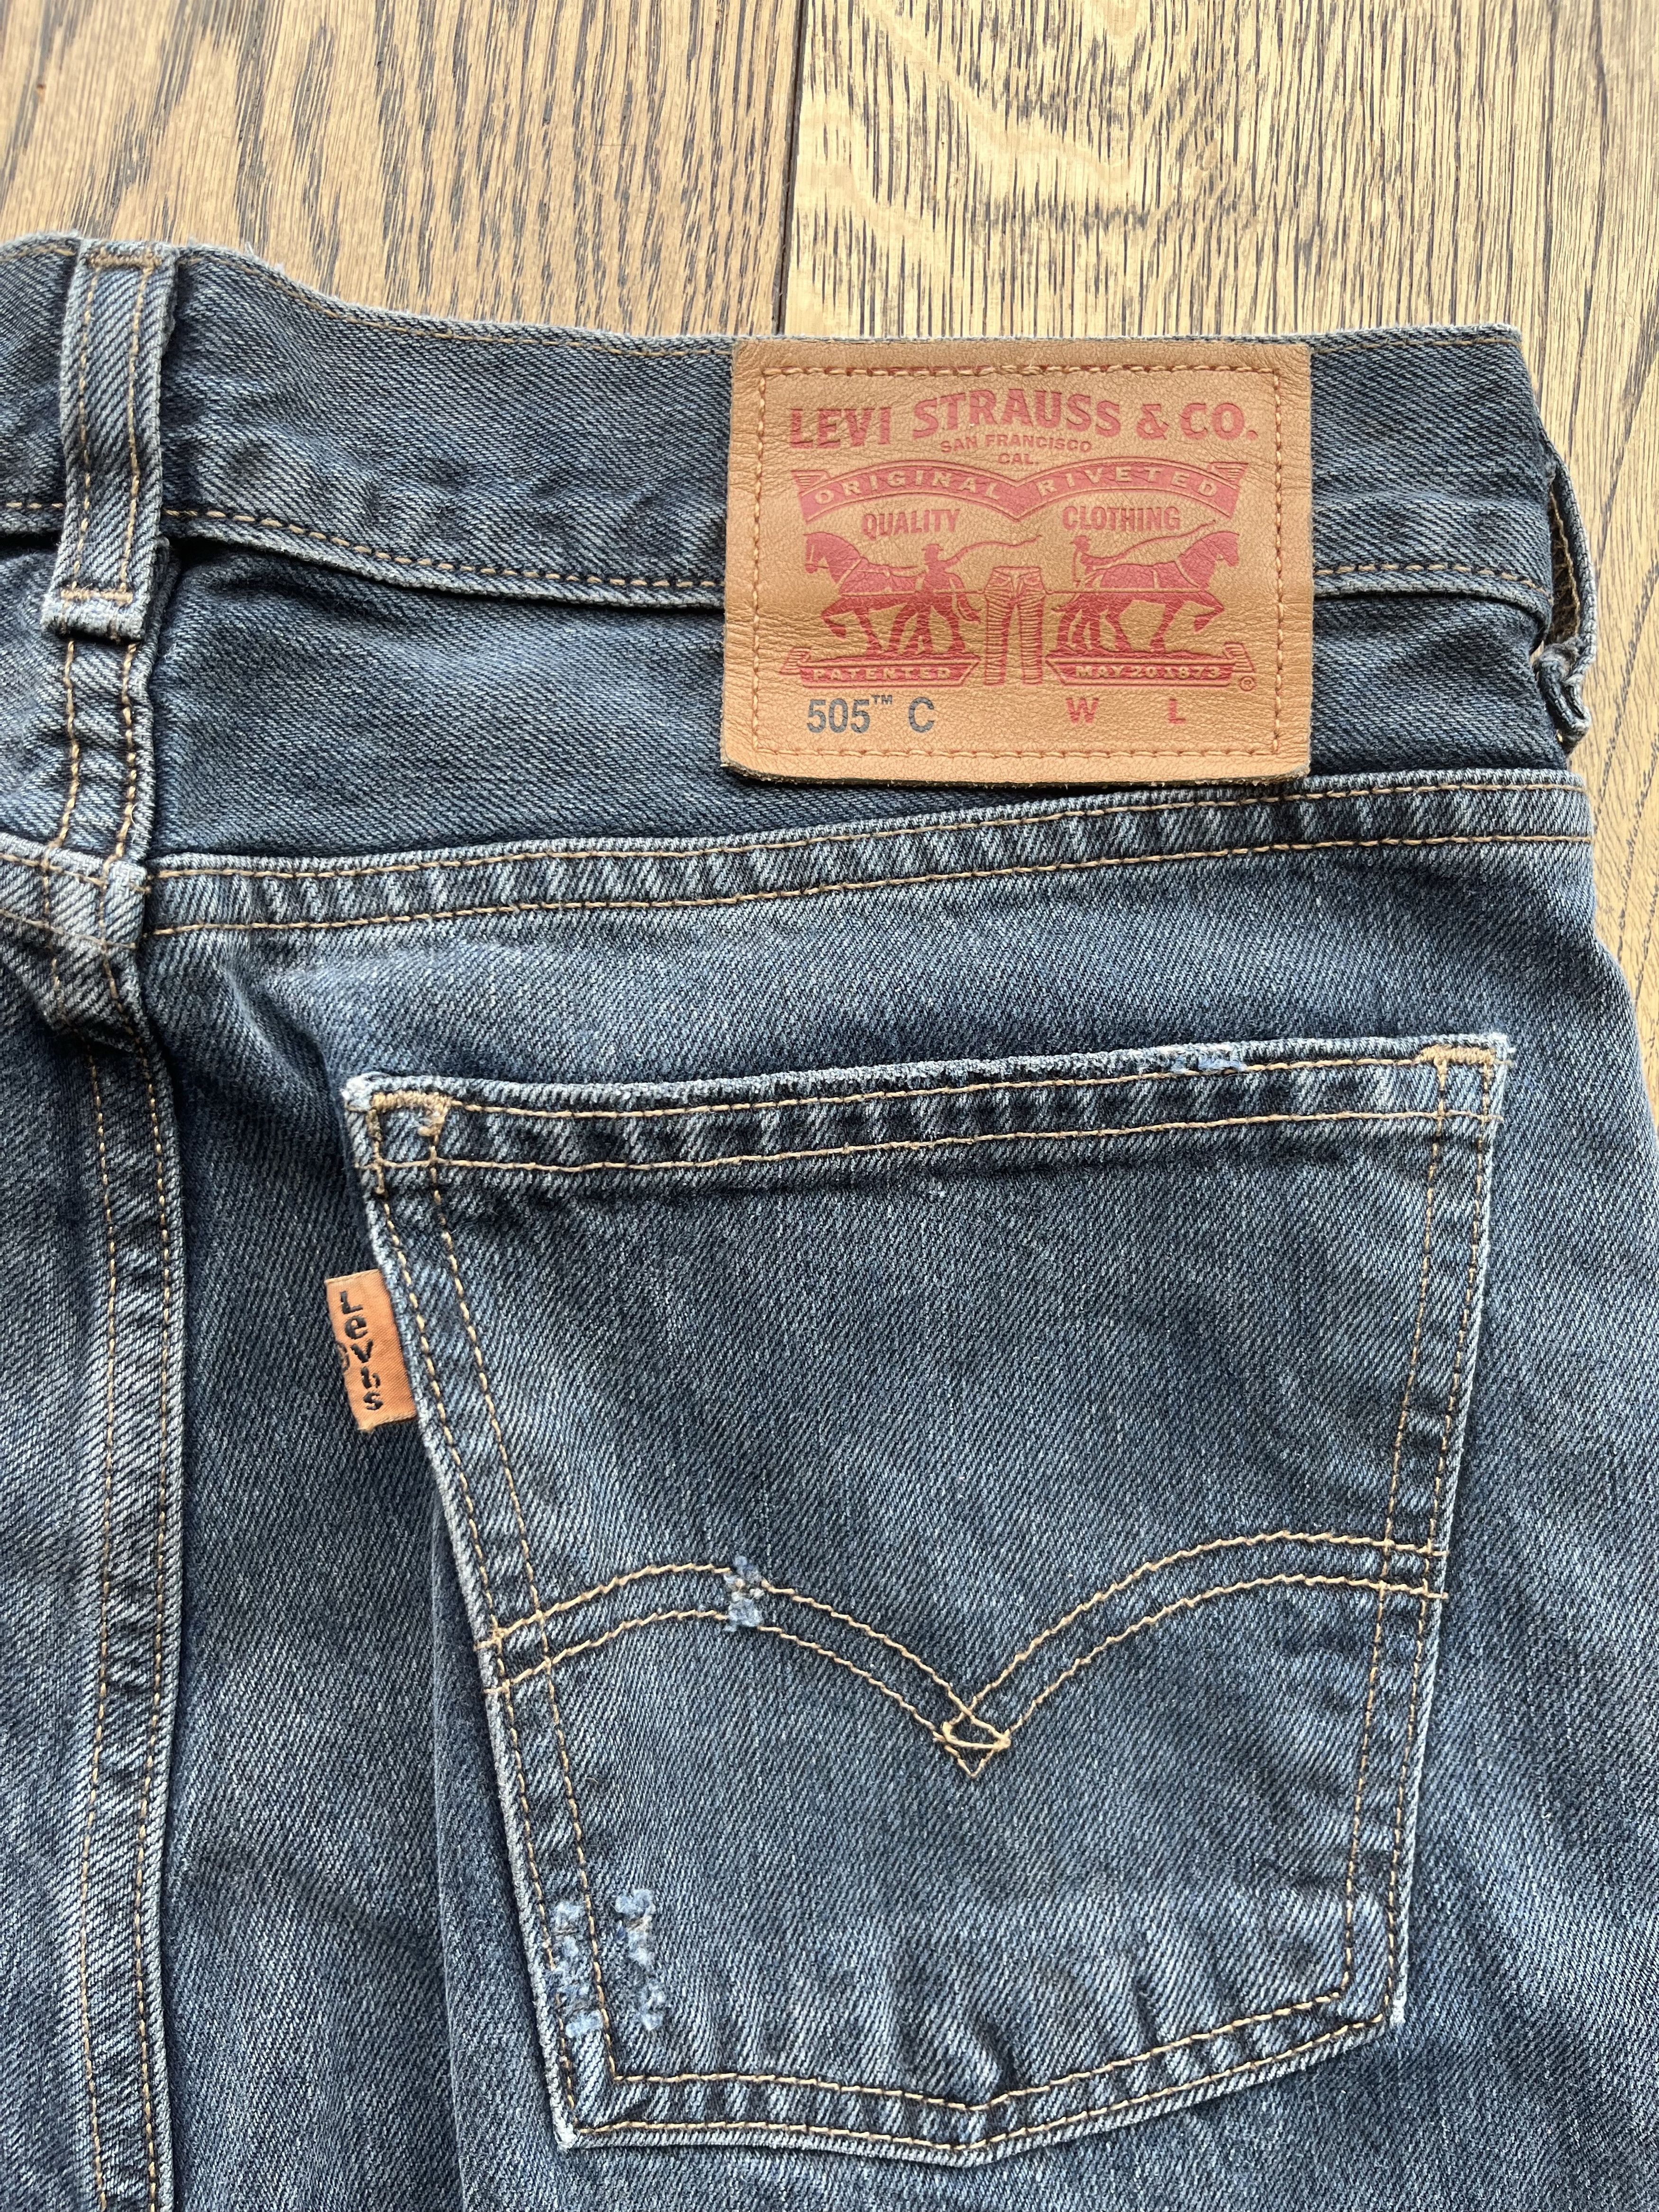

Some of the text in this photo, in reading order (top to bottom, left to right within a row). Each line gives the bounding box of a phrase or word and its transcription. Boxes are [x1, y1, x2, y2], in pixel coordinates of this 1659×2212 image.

[790, 388, 1258, 448] LEVI STRAUSS & CO.
[940, 435, 1091, 453] SAN FRANCISCO
[998, 453, 1039, 465] CAL.
[814, 466, 1218, 505] ORIGINAL RIVETED
[861, 508, 960, 540] QUALITY
[1062, 506, 1181, 532] CLOTHING
[812, 667, 951, 681] PATENTED
[1076, 665, 1124, 678] MAY
[1164, 666, 1221, 679] 1873
[908, 696, 935, 733] C
[1066, 698, 1099, 724] W
[1168, 698, 1186, 724] L
